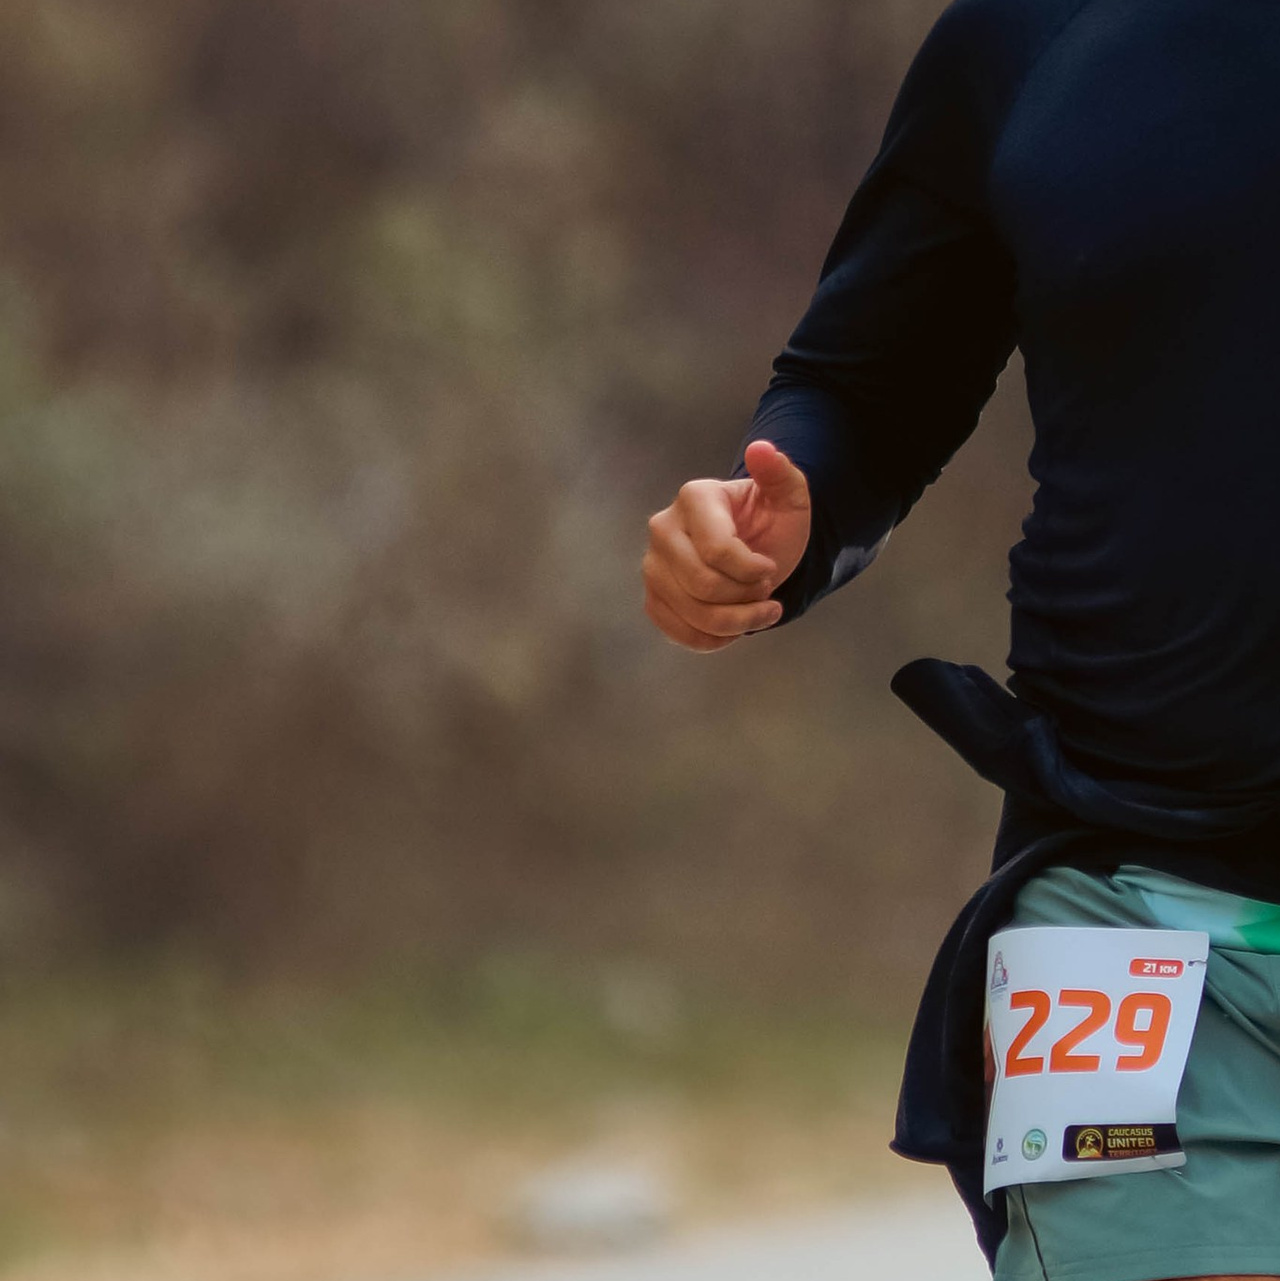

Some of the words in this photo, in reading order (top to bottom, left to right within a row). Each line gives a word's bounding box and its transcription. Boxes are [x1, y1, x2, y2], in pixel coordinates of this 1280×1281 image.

[1143, 962, 1157, 974] 21
[1005, 989, 1172, 1078] 229
[1108, 1128, 1154, 1137] CAUCASUS
[1107, 1137, 1156, 1149] UNITED
